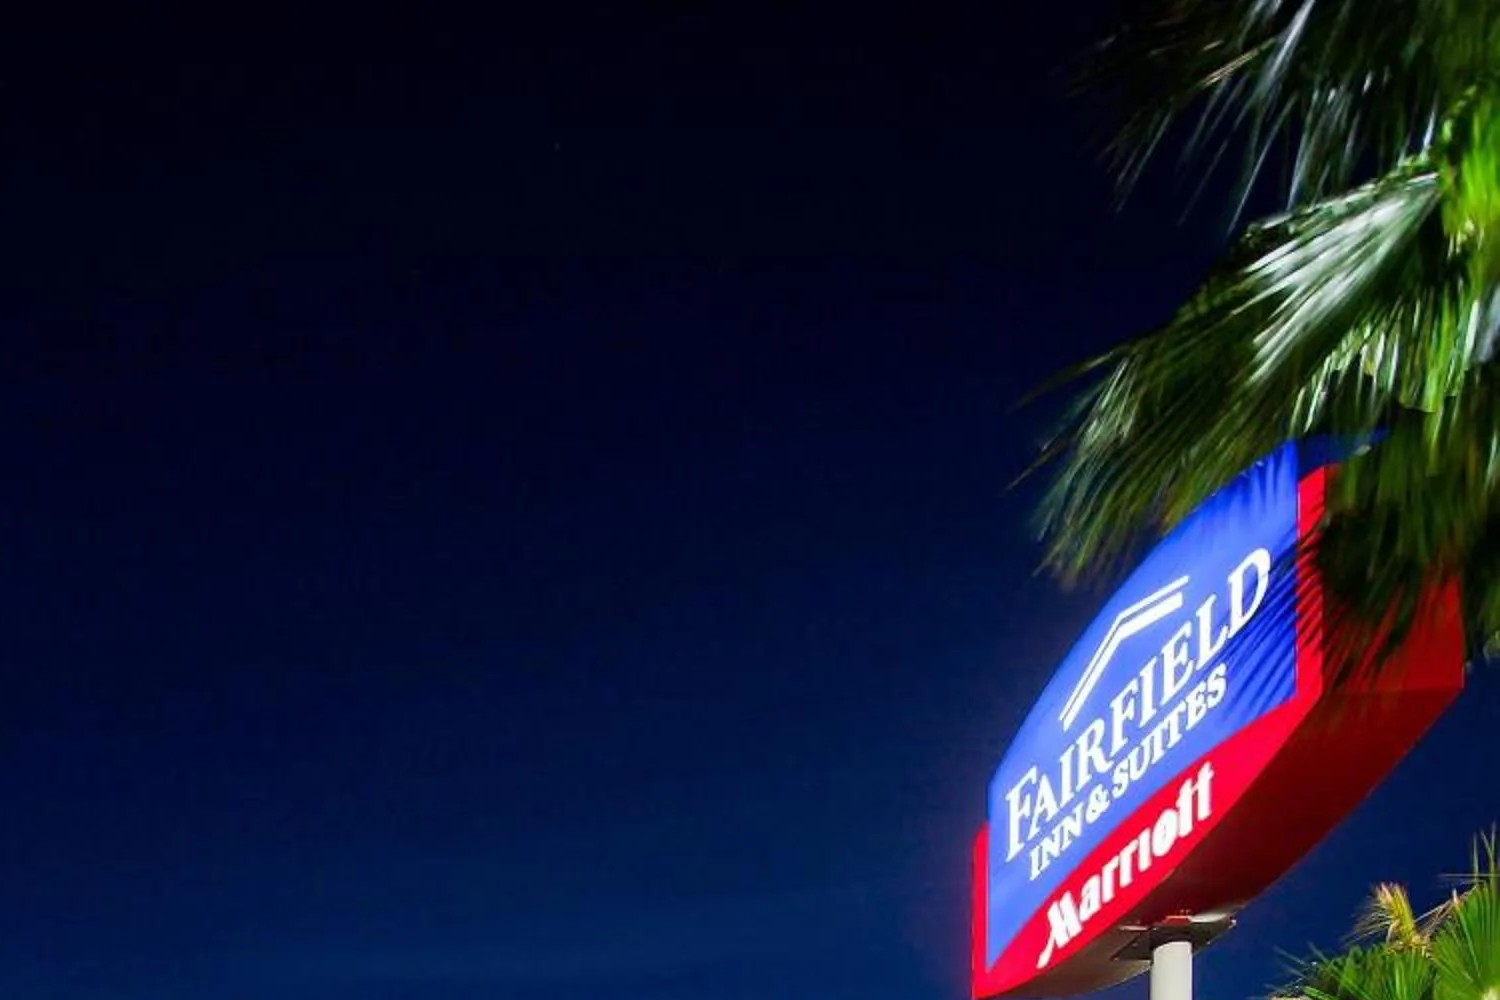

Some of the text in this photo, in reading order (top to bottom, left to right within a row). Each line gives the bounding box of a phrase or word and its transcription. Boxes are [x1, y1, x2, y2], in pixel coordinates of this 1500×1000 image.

[1005, 547, 1272, 863] FAIRFIELD
[1029, 663, 1227, 881] INN & SUITES
[1036, 761, 1215, 970] Marriott
